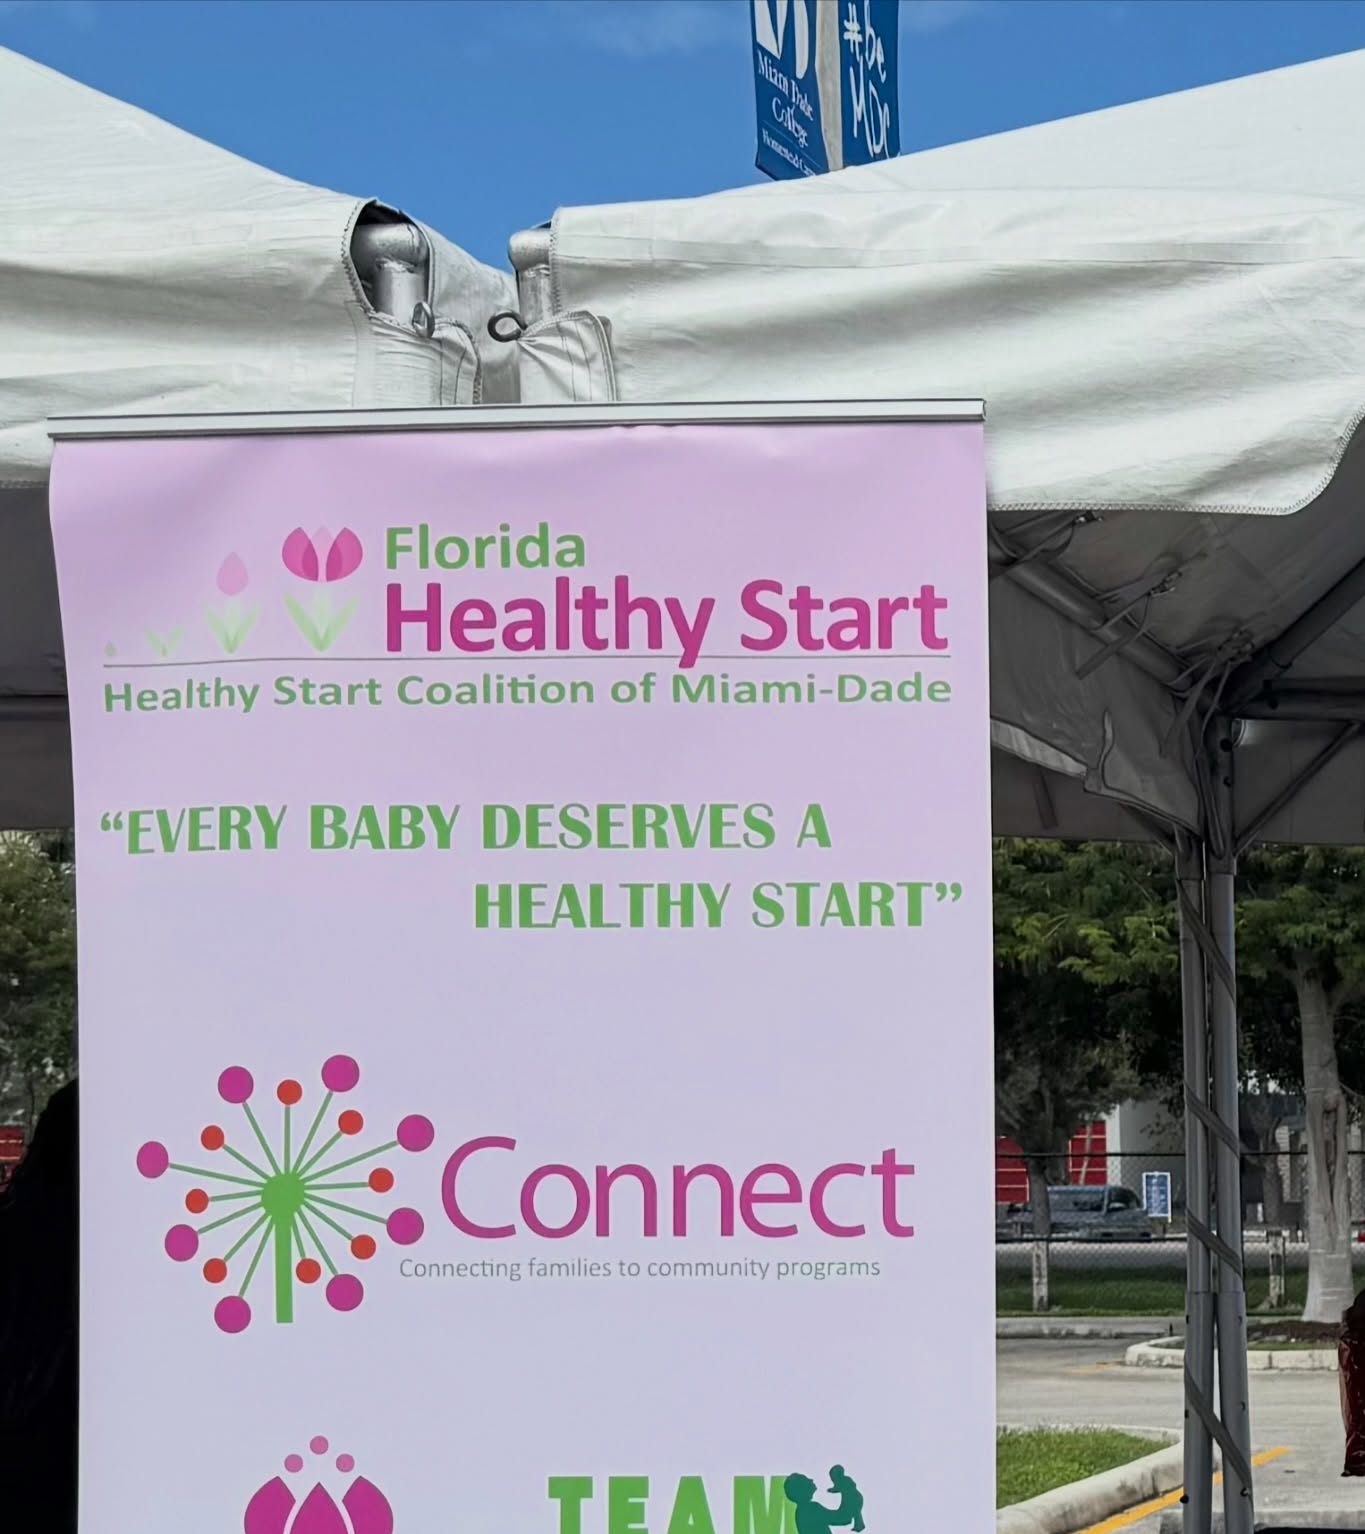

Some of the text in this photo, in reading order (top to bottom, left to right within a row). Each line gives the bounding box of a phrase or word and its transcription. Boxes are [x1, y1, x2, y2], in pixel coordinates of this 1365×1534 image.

[385, 522, 586, 571] Florida
[386, 575, 948, 669] Healthy Start
[104, 672, 952, 713] Healthy Start Coalition of Miami-Dade
[308, 803, 460, 852] BABY
[481, 802, 777, 851] DESERVES
[797, 803, 832, 849] A
[473, 881, 730, 930] HEALTHY
[441, 1136, 915, 1239] Connect
[400, 1258, 880, 1281] Connecting families to community programs
